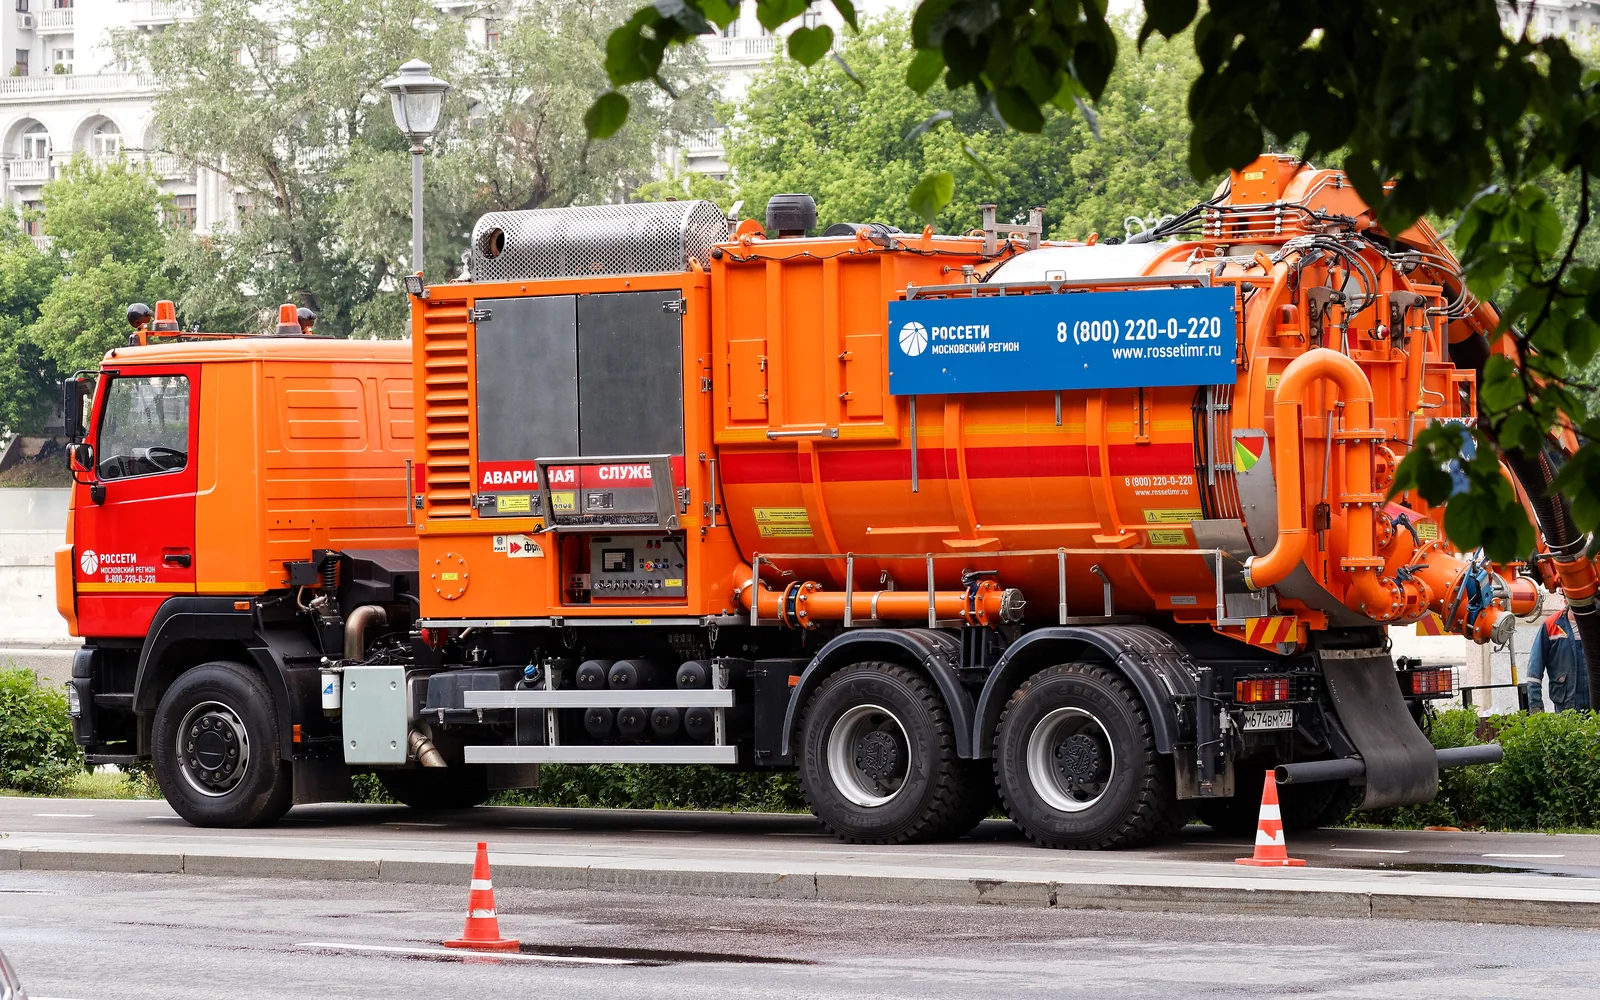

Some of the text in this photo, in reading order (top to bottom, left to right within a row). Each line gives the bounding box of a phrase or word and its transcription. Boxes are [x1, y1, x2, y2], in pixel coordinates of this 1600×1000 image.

[932, 324, 990, 341] РОССЕТИ
[1057, 316, 1221, 345] 8 (800) 220-0-220
[932, 341, 1020, 354] МОСКОВСКИЙ РЕГИОН
[1112, 342, 1221, 359] www.rossetimr.ru
[599, 465, 653, 480] СЛУЖБ
[1125, 475, 1193, 488] 8 (800) 220-0-220
[1134, 488, 1189, 496] www.rossetimr.ru
[100, 553, 137, 564] РОССЕТИ
[100, 565, 135, 574] МОСКОВСКИЙ
[105, 575, 156, 583] 8-800-220-0-220
[1278, 710, 1291, 722] 977
